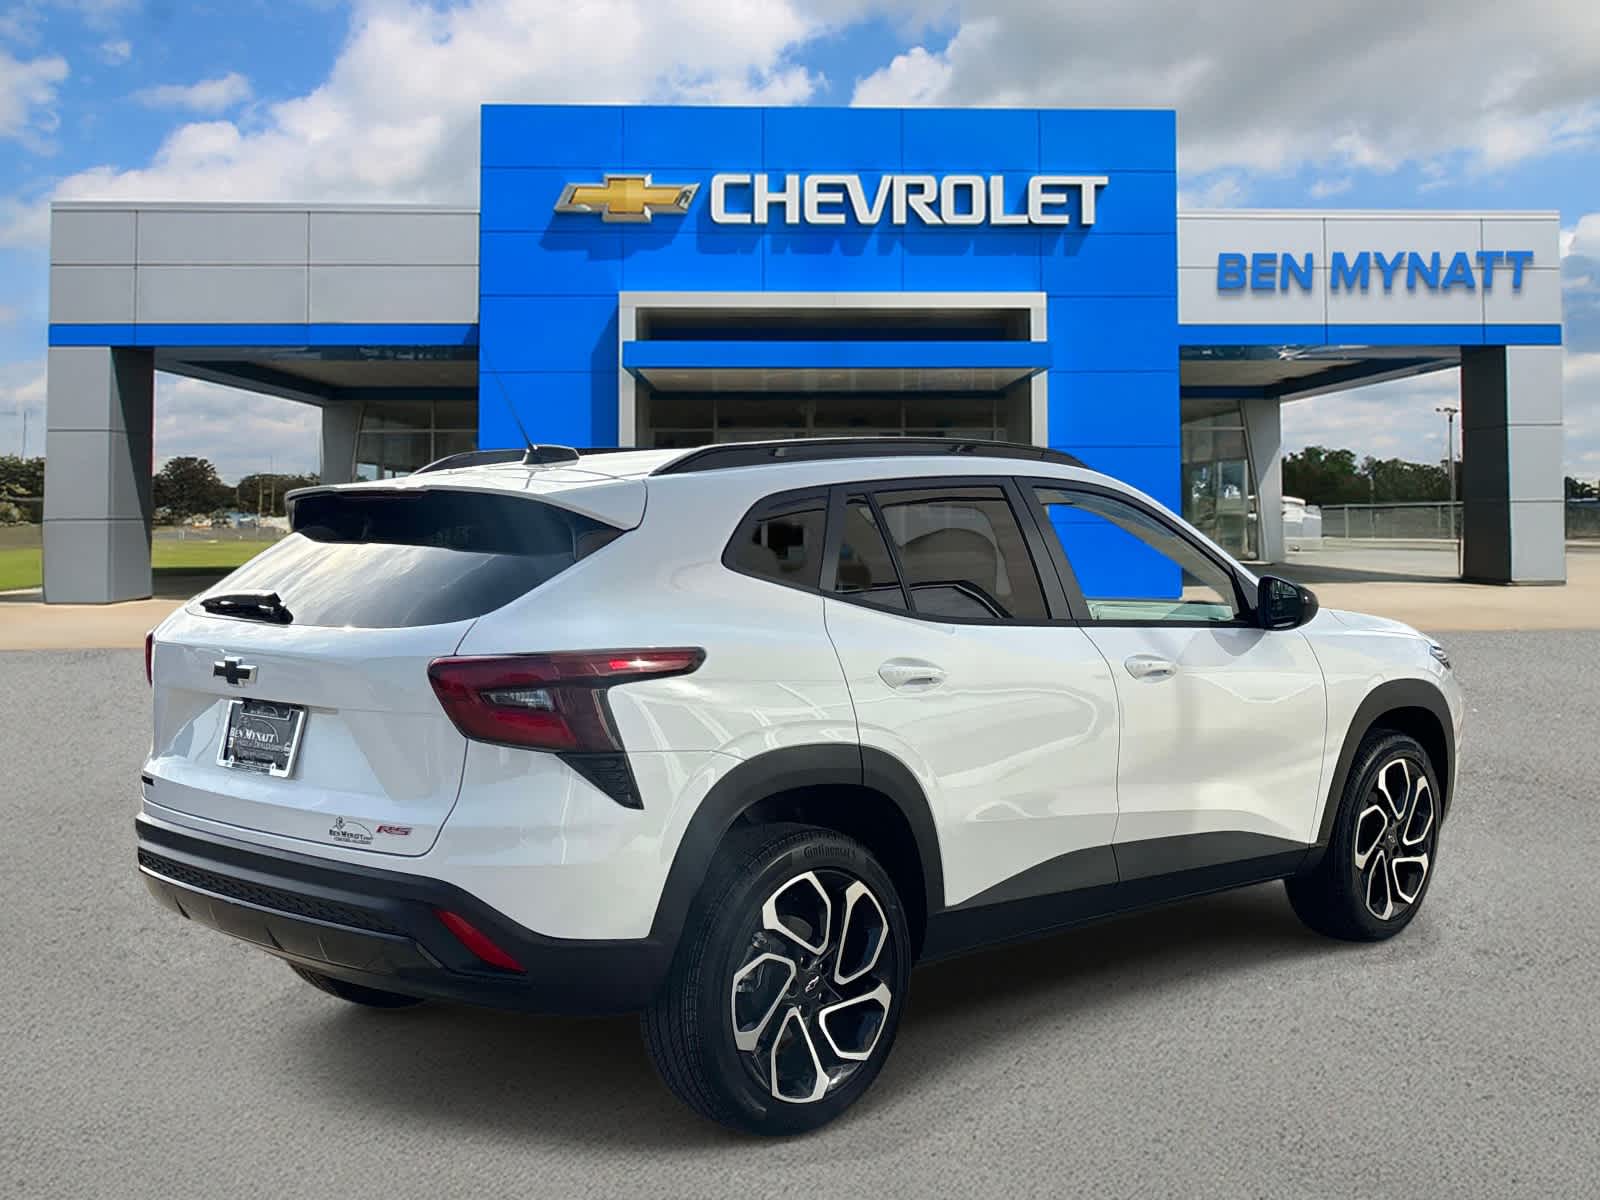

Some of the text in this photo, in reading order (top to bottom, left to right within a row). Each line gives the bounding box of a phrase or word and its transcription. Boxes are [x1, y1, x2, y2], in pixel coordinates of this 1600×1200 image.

[710, 174, 1109, 225] CHEVROLET
[1217, 251, 1534, 290] BEN MYNATT
[376, 824, 413, 836] RS
